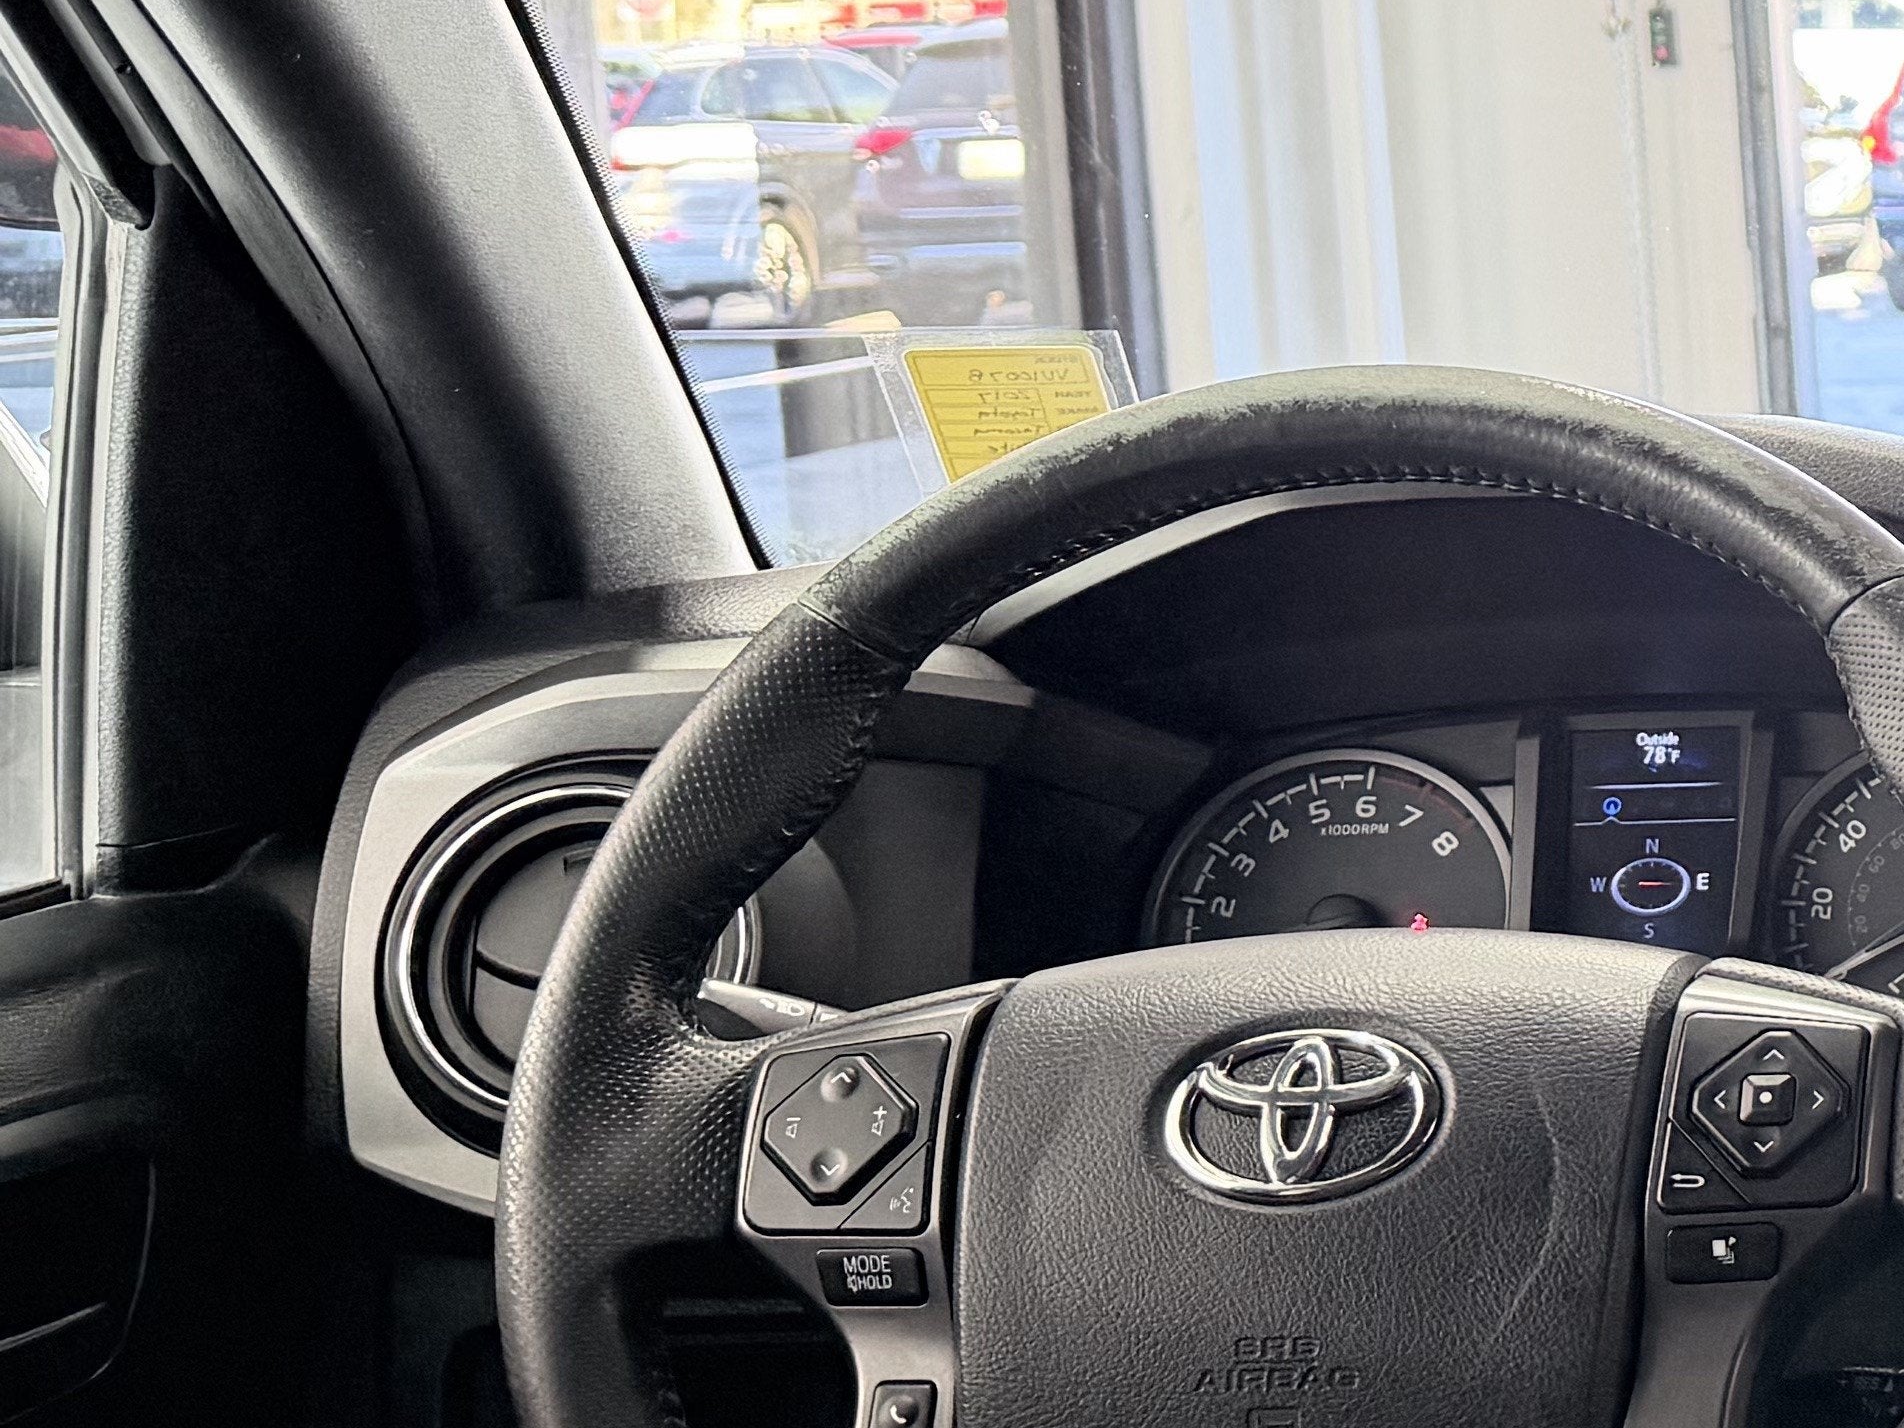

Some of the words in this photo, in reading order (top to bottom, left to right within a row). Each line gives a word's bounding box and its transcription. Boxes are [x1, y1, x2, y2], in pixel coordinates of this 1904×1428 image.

[1635, 732, 1680, 747] Outside
[1308, 799, 1331, 823] 5
[1355, 795, 1377, 818] 6
[1399, 804, 1424, 827] 7
[1268, 819, 1290, 843] 4
[1838, 819, 1867, 854] 40
[1431, 831, 1460, 857] 8
[1645, 838, 1660, 854] N
[1230, 853, 1256, 878] 3
[1590, 877, 1607, 893] W
[1696, 872, 1710, 892] E
[1211, 896, 1236, 918] 2
[1811, 887, 1834, 920] 20
[1644, 923, 1655, 940] S
[842, 1255, 892, 1274] MODE
[857, 1274, 893, 1290] HOLD
